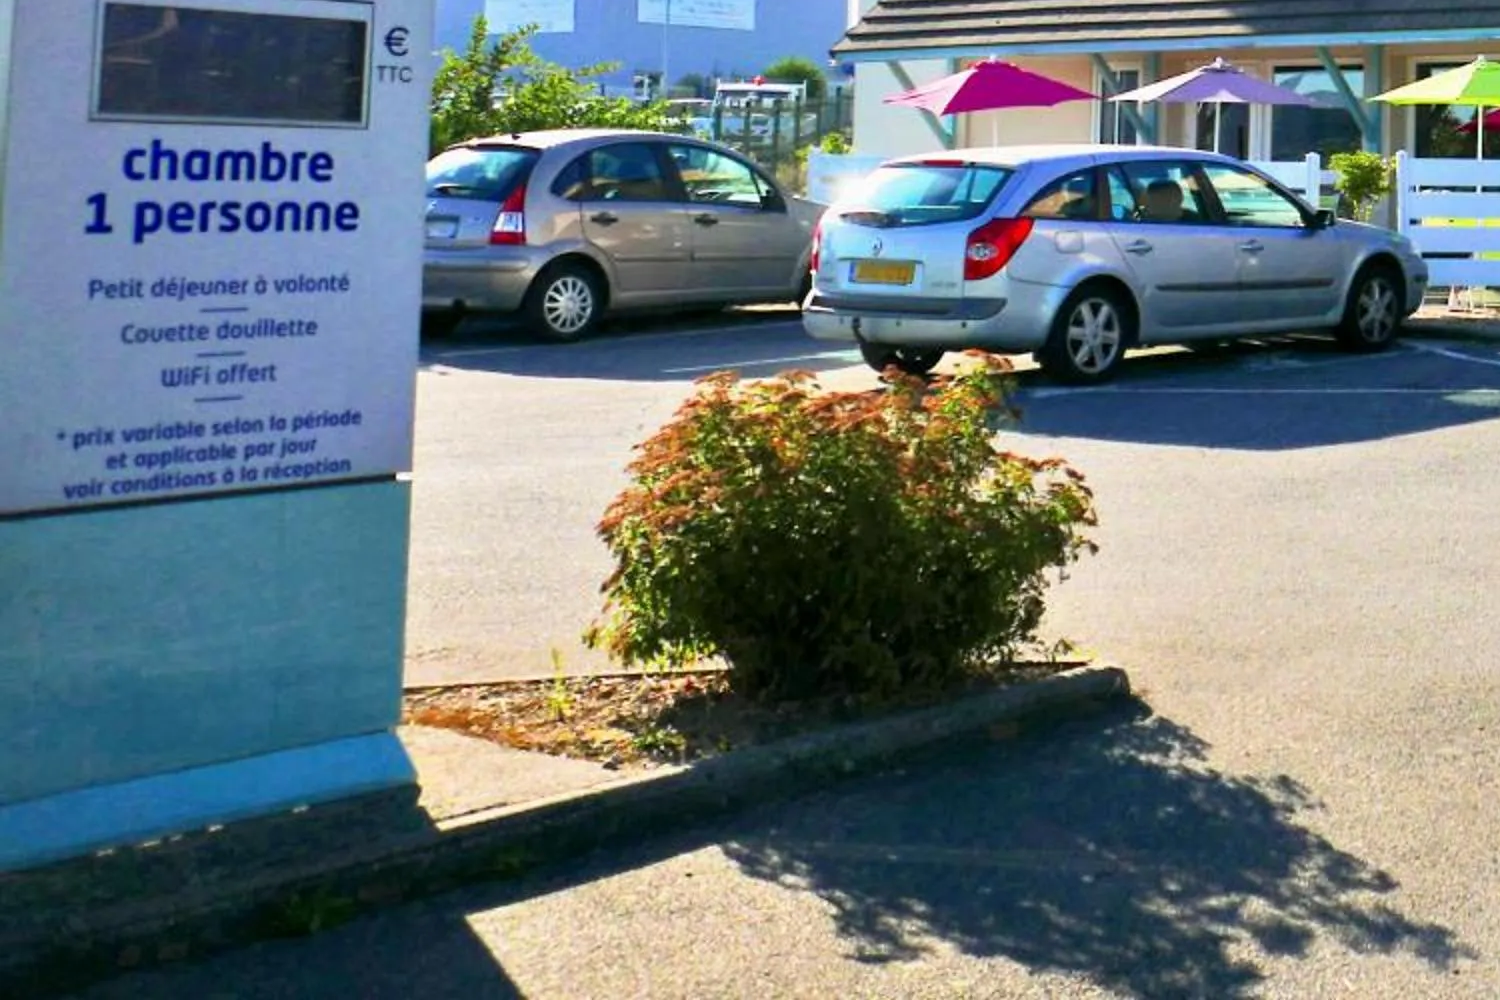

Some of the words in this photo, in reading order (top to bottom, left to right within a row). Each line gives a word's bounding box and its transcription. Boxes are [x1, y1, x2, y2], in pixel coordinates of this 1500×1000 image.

[384, 26, 410, 57] €
[376, 64, 413, 83] TTC
[122, 138, 335, 183] chambre
[84, 192, 113, 234] 1
[133, 198, 360, 244] personne
[88, 277, 143, 299] Petit
[151, 276, 248, 301] déjeuner
[254, 275, 267, 293] à
[273, 273, 350, 293] volonté
[120, 322, 210, 345] Couette
[216, 318, 318, 342] douillette
[161, 366, 210, 388] WiFi
[216, 364, 277, 385] offert
[72, 424, 114, 450] prix
[122, 419, 206, 443] variable
[212, 415, 264, 436] selon
[269, 414, 287, 433] la
[291, 409, 362, 434] période
[105, 452, 127, 471] et
[134, 441, 236, 473] applicable
[244, 440, 275, 461] par
[280, 437, 317, 458] jour
[63, 479, 103, 500] voir
[110, 469, 216, 496] conditions
[222, 467, 234, 485] à
[240, 463, 258, 482] la
[263, 456, 352, 482] réception
